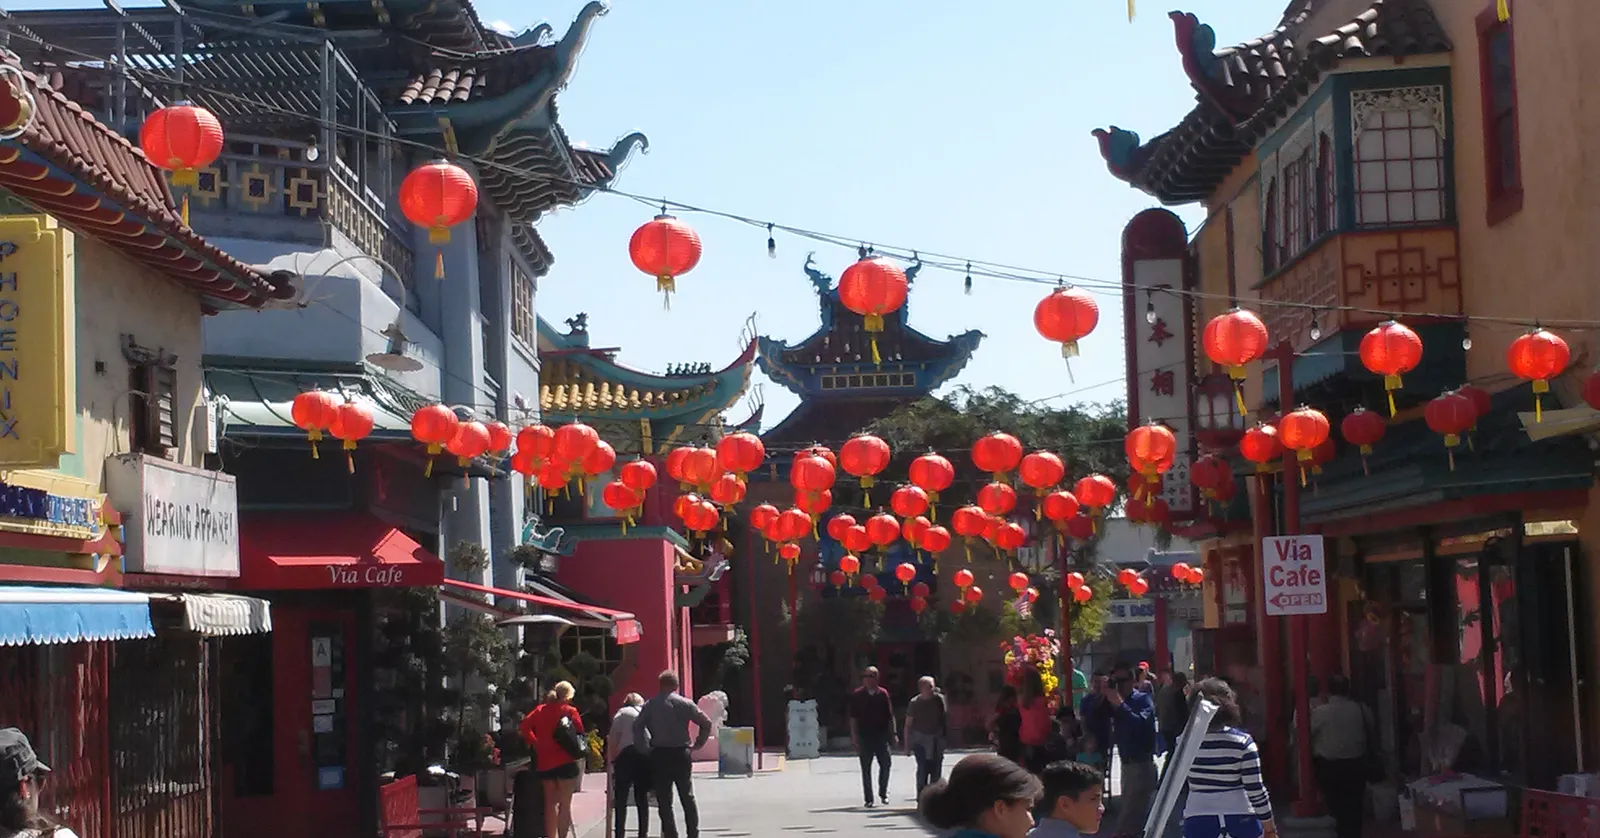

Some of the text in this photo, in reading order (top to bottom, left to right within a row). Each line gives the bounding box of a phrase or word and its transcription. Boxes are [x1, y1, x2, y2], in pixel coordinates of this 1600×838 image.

[0, 240, 19, 441] PHOENIX
[146, 493, 191, 539] WEARING
[1274, 539, 1312, 561] Via
[327, 565, 402, 586] Via Cafe
[1270, 564, 1321, 587] Cafe
[1280, 594, 1322, 606] OPEN
[316, 643, 327, 657] A
